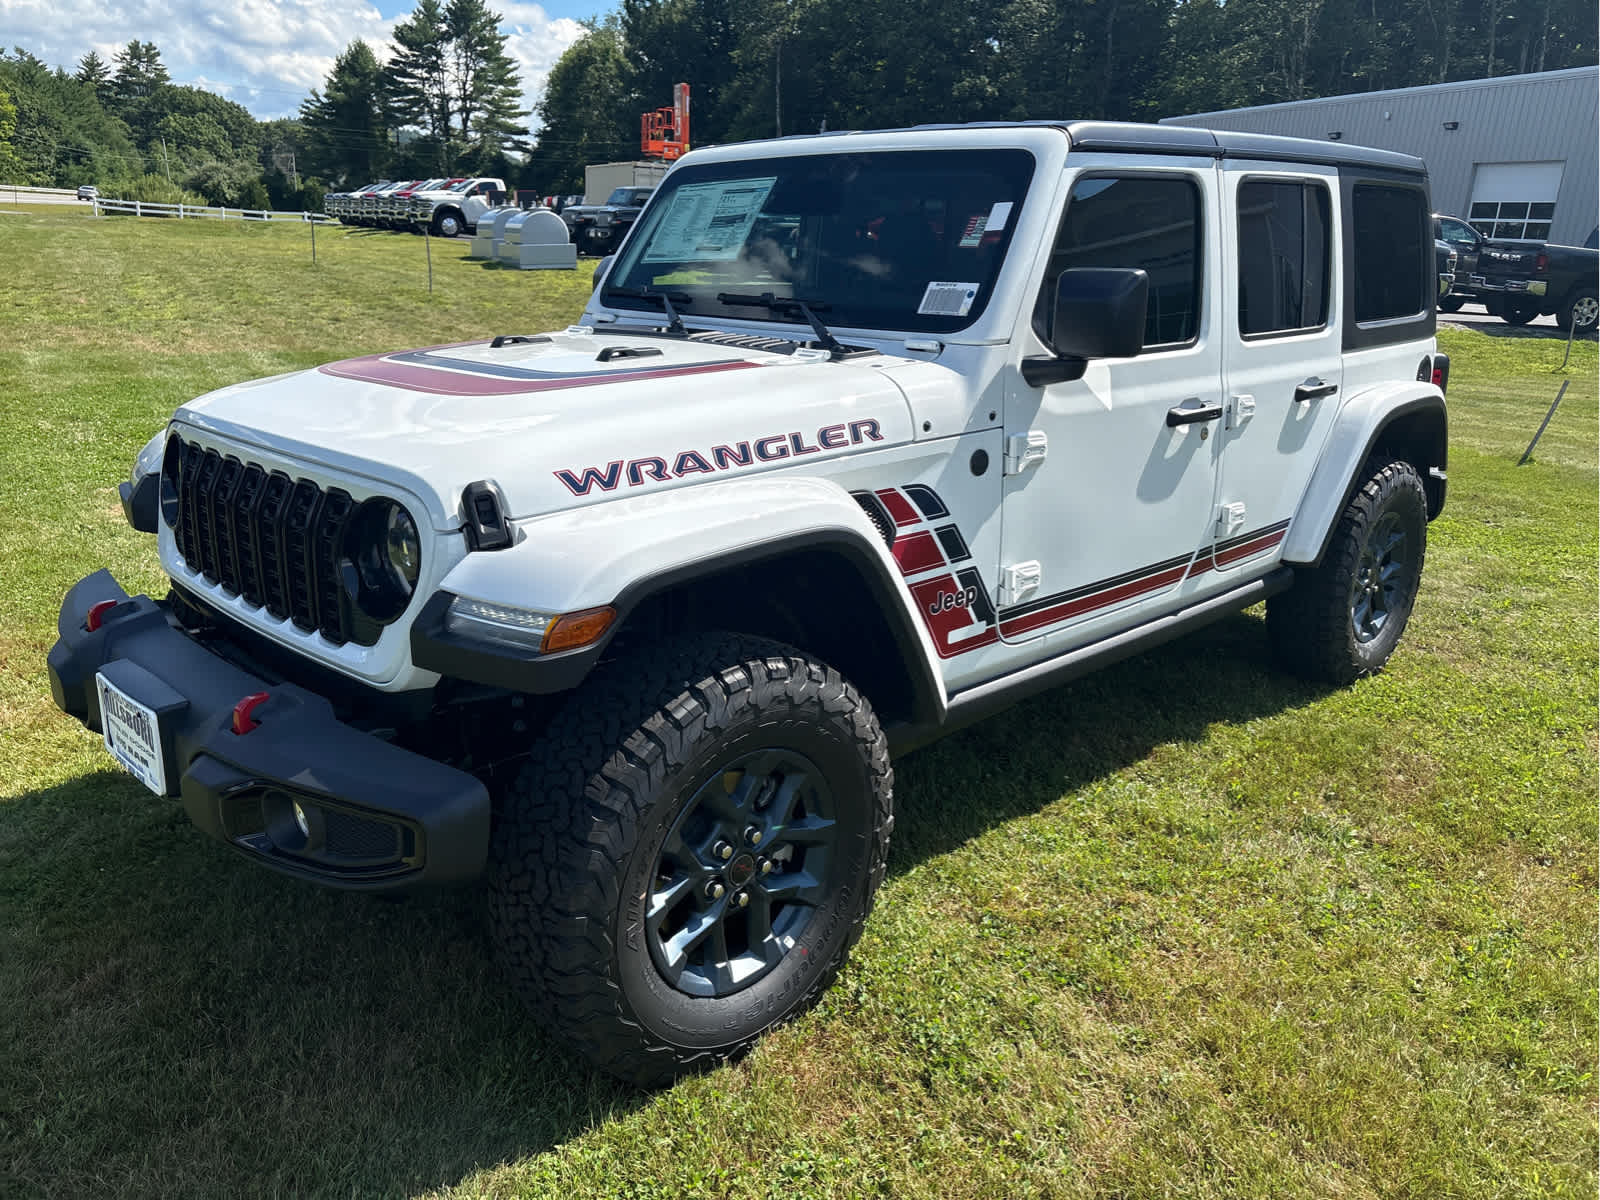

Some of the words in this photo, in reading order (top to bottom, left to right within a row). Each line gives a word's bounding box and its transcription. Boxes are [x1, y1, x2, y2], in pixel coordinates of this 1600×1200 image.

[1490, 251, 1521, 262] RAM
[552, 418, 884, 496] WRANGLER
[929, 586, 977, 615] Jeep
